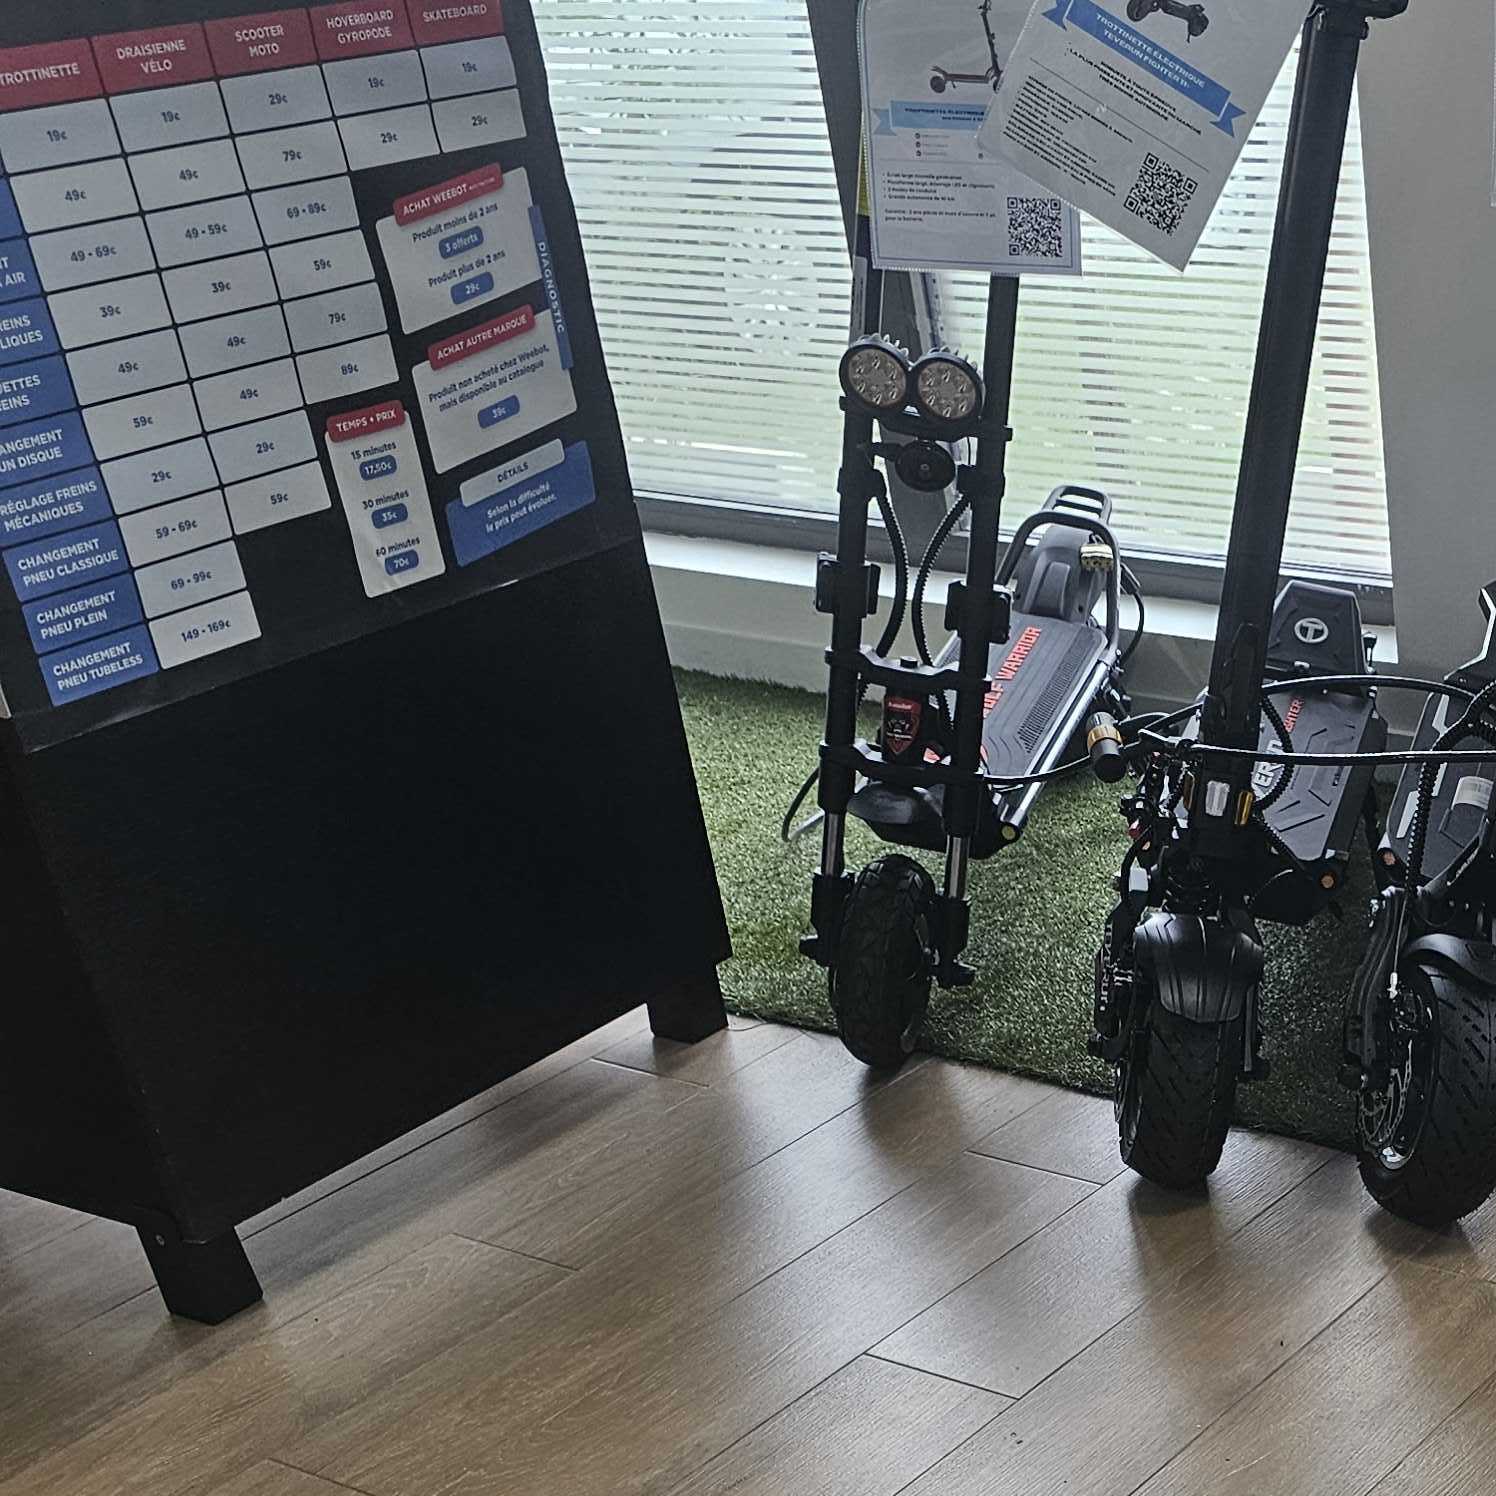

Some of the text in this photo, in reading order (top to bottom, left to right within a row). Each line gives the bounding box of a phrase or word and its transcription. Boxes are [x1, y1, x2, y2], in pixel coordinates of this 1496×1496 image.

[327, 10, 393, 29] HOVERBOARD
[423, 4, 487, 22] SKATEBOARD
[235, 25, 284, 43] SCOOTER
[338, 27, 392, 44] GYROPODE
[1096, 14, 1153, 54] TROTTINETTE
[116, 40, 186, 59] DRAISIENNE
[248, 43, 280, 57] MOTO
[0, 63, 80, 86] TROTTINETTE
[141, 59, 172, 74] VÉLO
[404, 198, 431, 215] ACHAT
[412, 224, 443, 242] Produit
[468, 210, 478, 219] de
[5, 272, 26, 287] AIR
[429, 269, 457, 287] Produit
[458, 263, 474, 277] plus
[475, 258, 484, 268] de
[538, 242, 565, 333] DIAGNOSTIC
[0, 315, 31, 331] EINS
[437, 314, 527, 360] ACHAT AUTRE MARQUE
[0, 395, 30, 411] EINS
[336, 409, 397, 433] TEMPS PRIX
[18, 446, 63, 468] DISQUE
[363, 441, 396, 458] minutes
[0, 480, 97, 517] RÉGLAGE FREINS
[375, 490, 409, 506] minutes
[4, 501, 84, 532] MÉCANIQUES
[18, 538, 100, 570] CHANGEMENT
[388, 536, 420, 553] minutes
[23, 550, 119, 587] PNEU CLASSIQUE
[37, 590, 116, 624] CHANGEMENT
[40, 610, 108, 639] PNEU PLEIN
[53, 642, 131, 676] CHANGEMENT
[995, 626, 1042, 681] WARRIOR
[58, 654, 143, 690] PNEU TUBELESS
